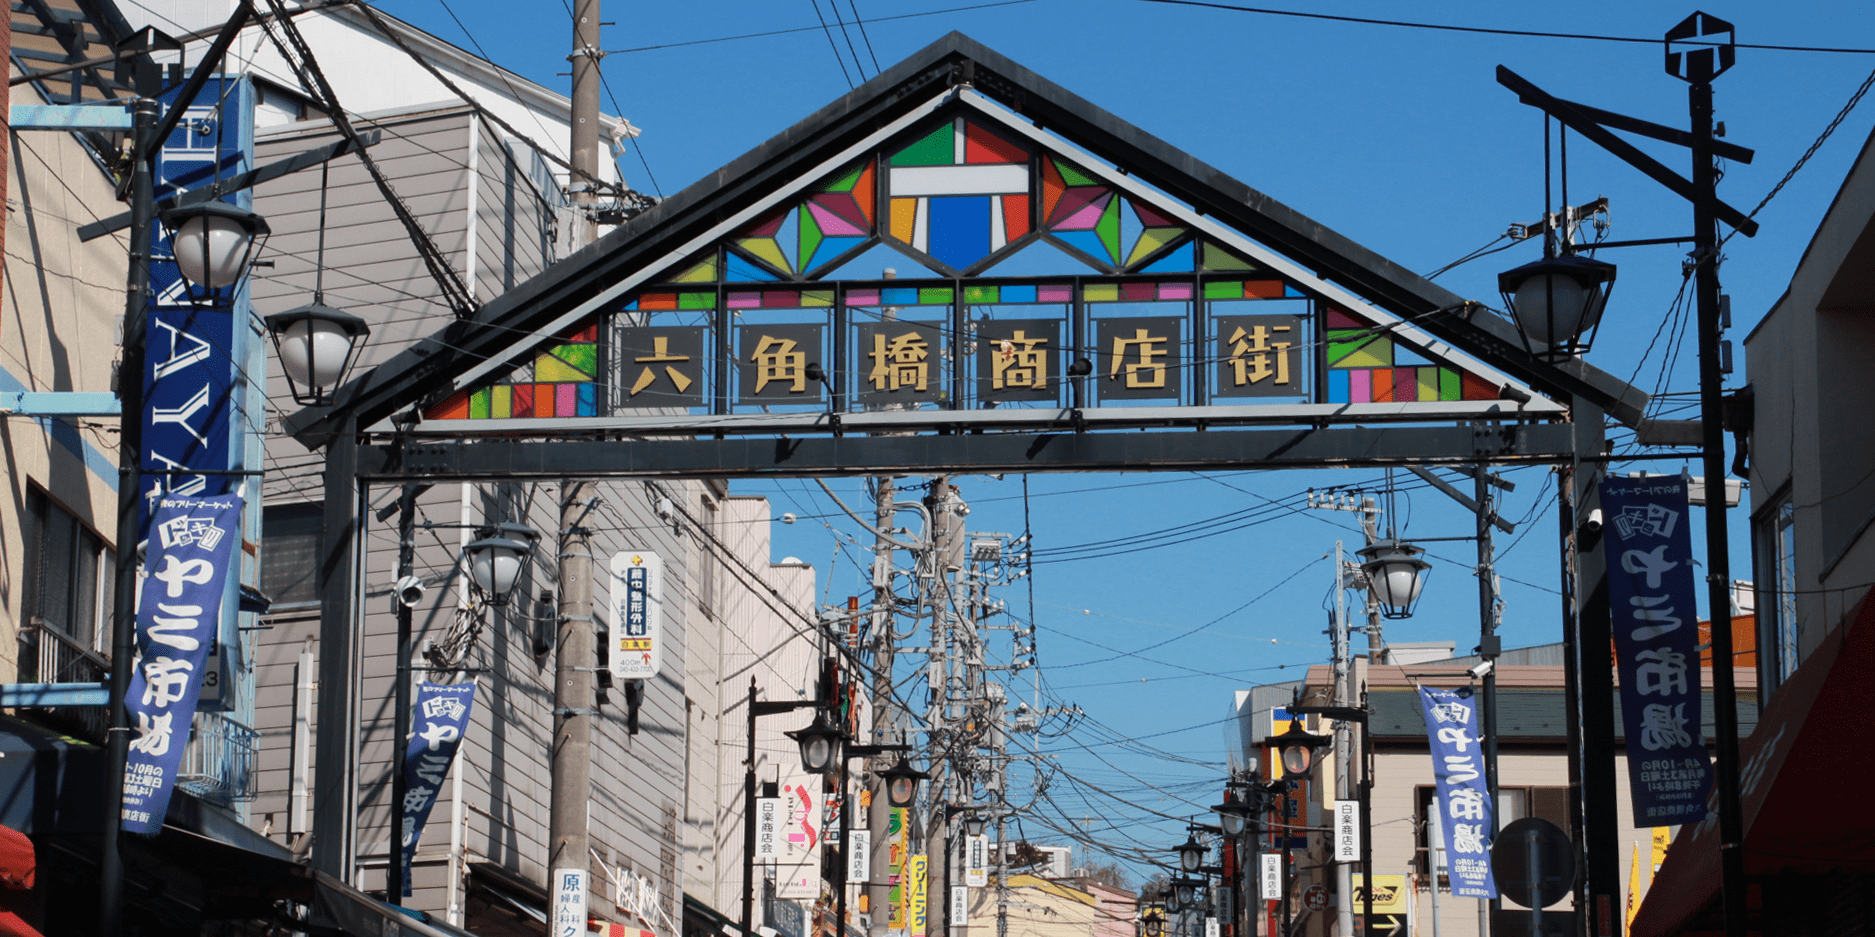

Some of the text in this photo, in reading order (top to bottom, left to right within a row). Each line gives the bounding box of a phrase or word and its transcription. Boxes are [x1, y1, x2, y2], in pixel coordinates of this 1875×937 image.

[630, 325, 1291, 395] 六角橋商店街
[130, 554, 214, 756] ヤミ市場
[761, 802, 774, 854] 白楽商店会
[1341, 804, 1353, 856] 白楽商店会
[853, 833, 863, 878] 白楽商店会
[1267, 857, 1277, 897] 白楽商店会
[562, 874, 580, 892] 原
[915, 861, 926, 927] クリーニング
